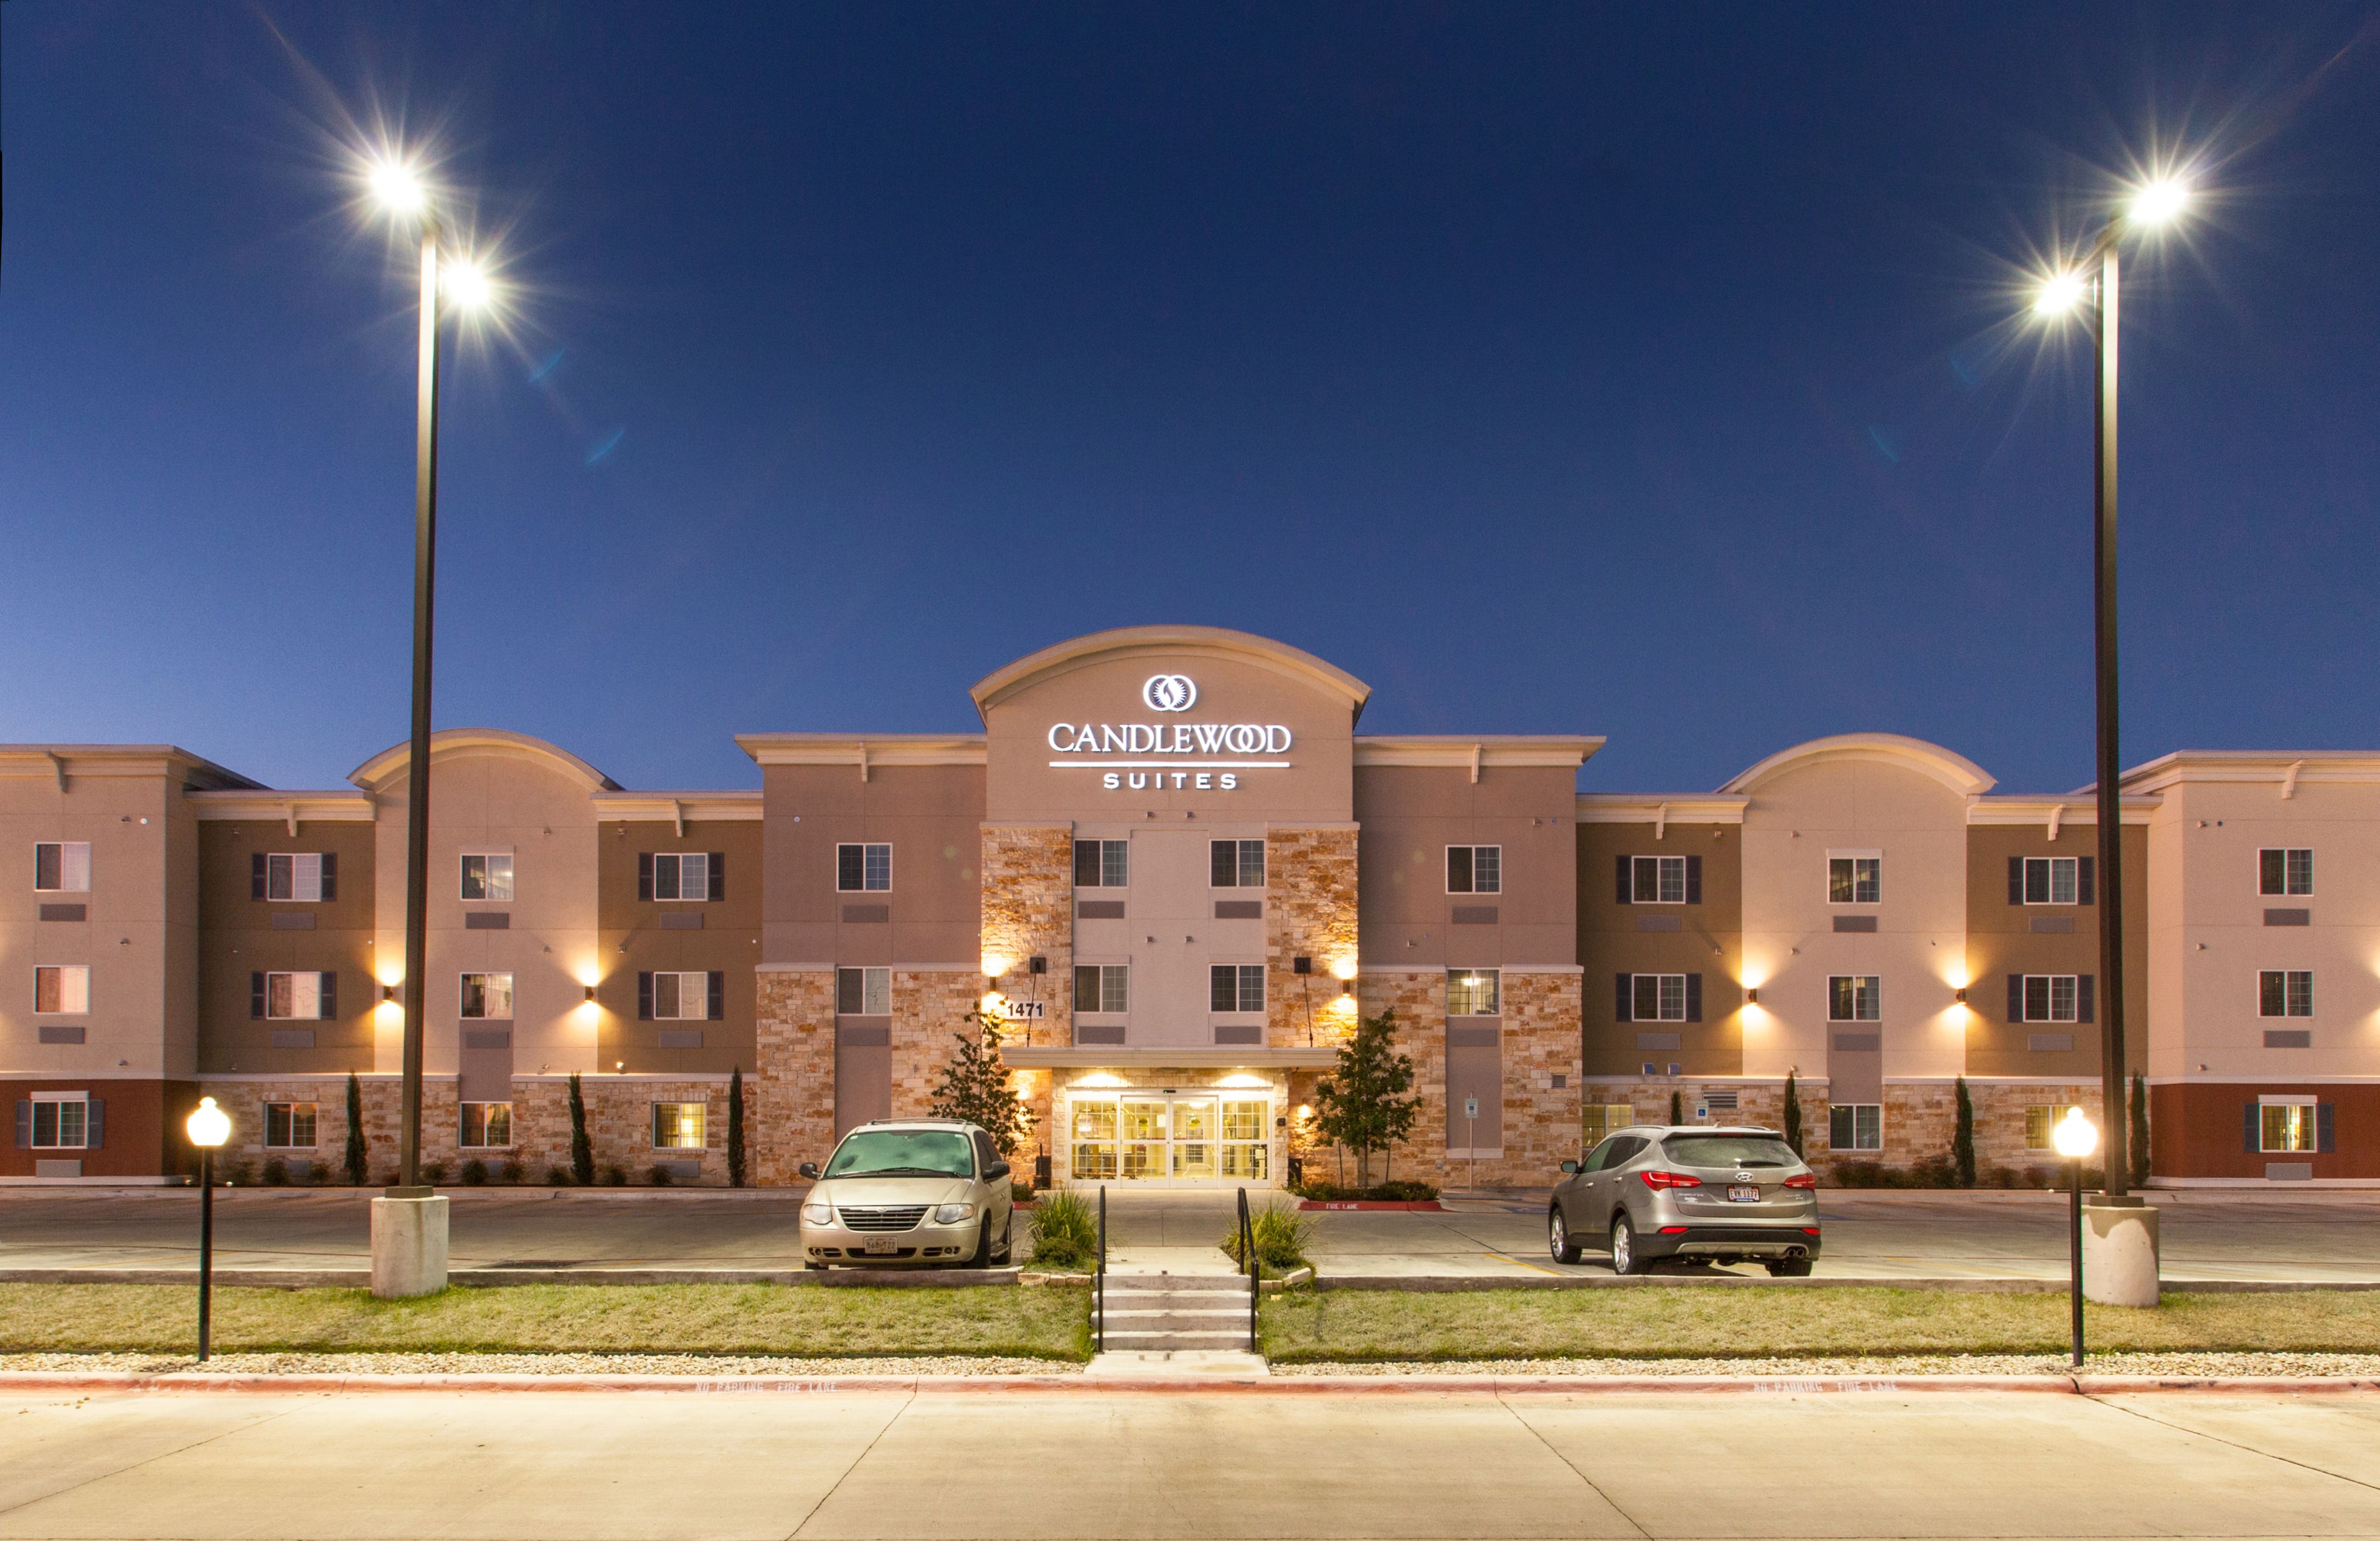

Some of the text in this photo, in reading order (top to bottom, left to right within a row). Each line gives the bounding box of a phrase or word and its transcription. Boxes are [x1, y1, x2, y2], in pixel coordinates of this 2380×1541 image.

[1048, 723, 1292, 753] CANDLEWOOD
[1103, 773, 1237, 790] SUITES
[1008, 1003, 1043, 1017] 1471
[695, 1382, 838, 1394] NO PARKING FIRE LANE
[1754, 1382, 1899, 1393] NO PARKING FIRE LANE
